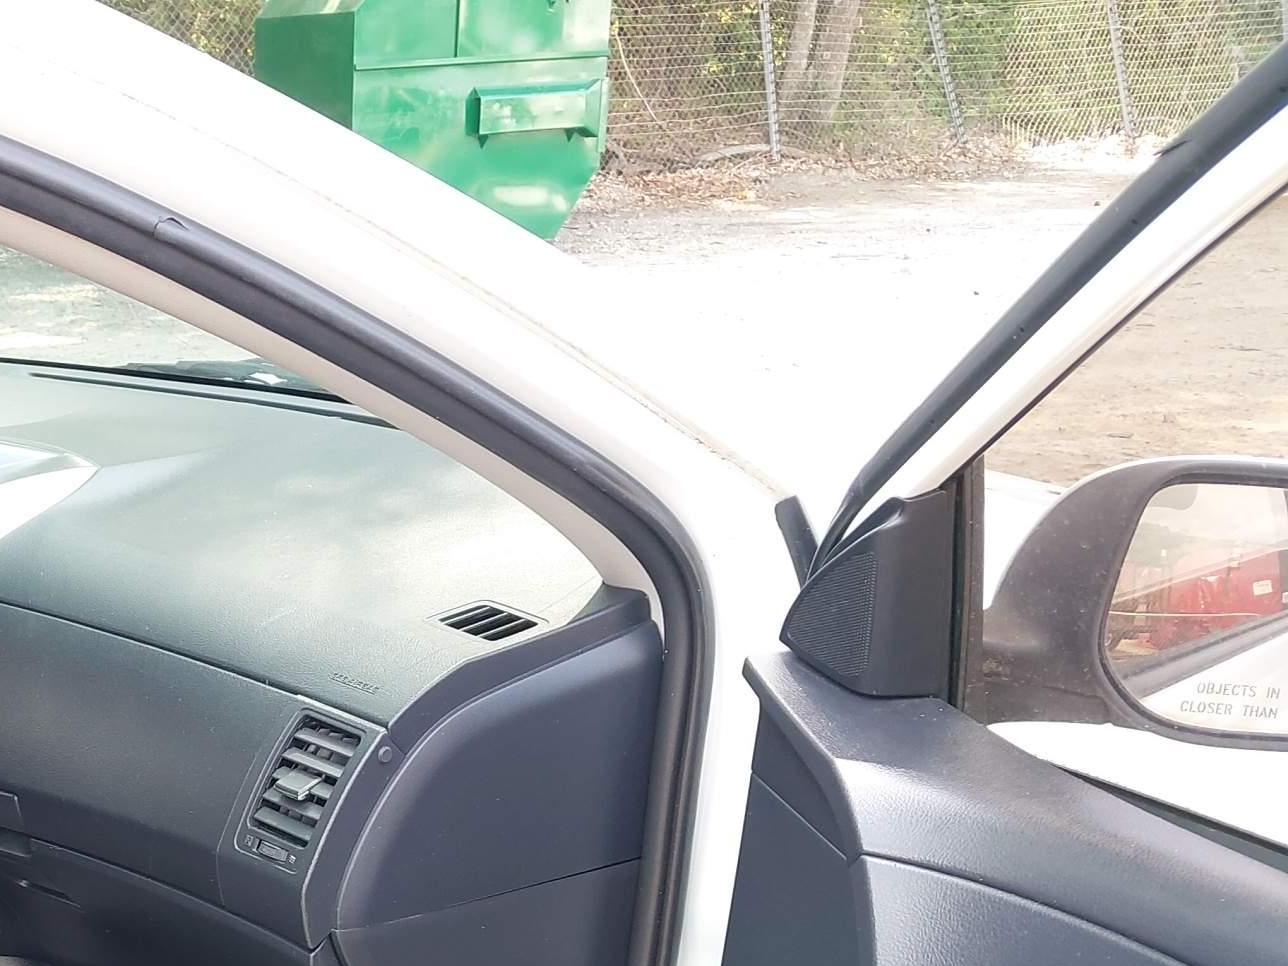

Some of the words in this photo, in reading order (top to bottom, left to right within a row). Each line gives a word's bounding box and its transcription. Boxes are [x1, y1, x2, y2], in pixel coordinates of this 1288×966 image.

[1197, 681, 1257, 698] OBJECTS
[1266, 686, 1281, 699] IN
[1180, 700, 1233, 715] CLOSER
[1243, 704, 1279, 719] THAN
